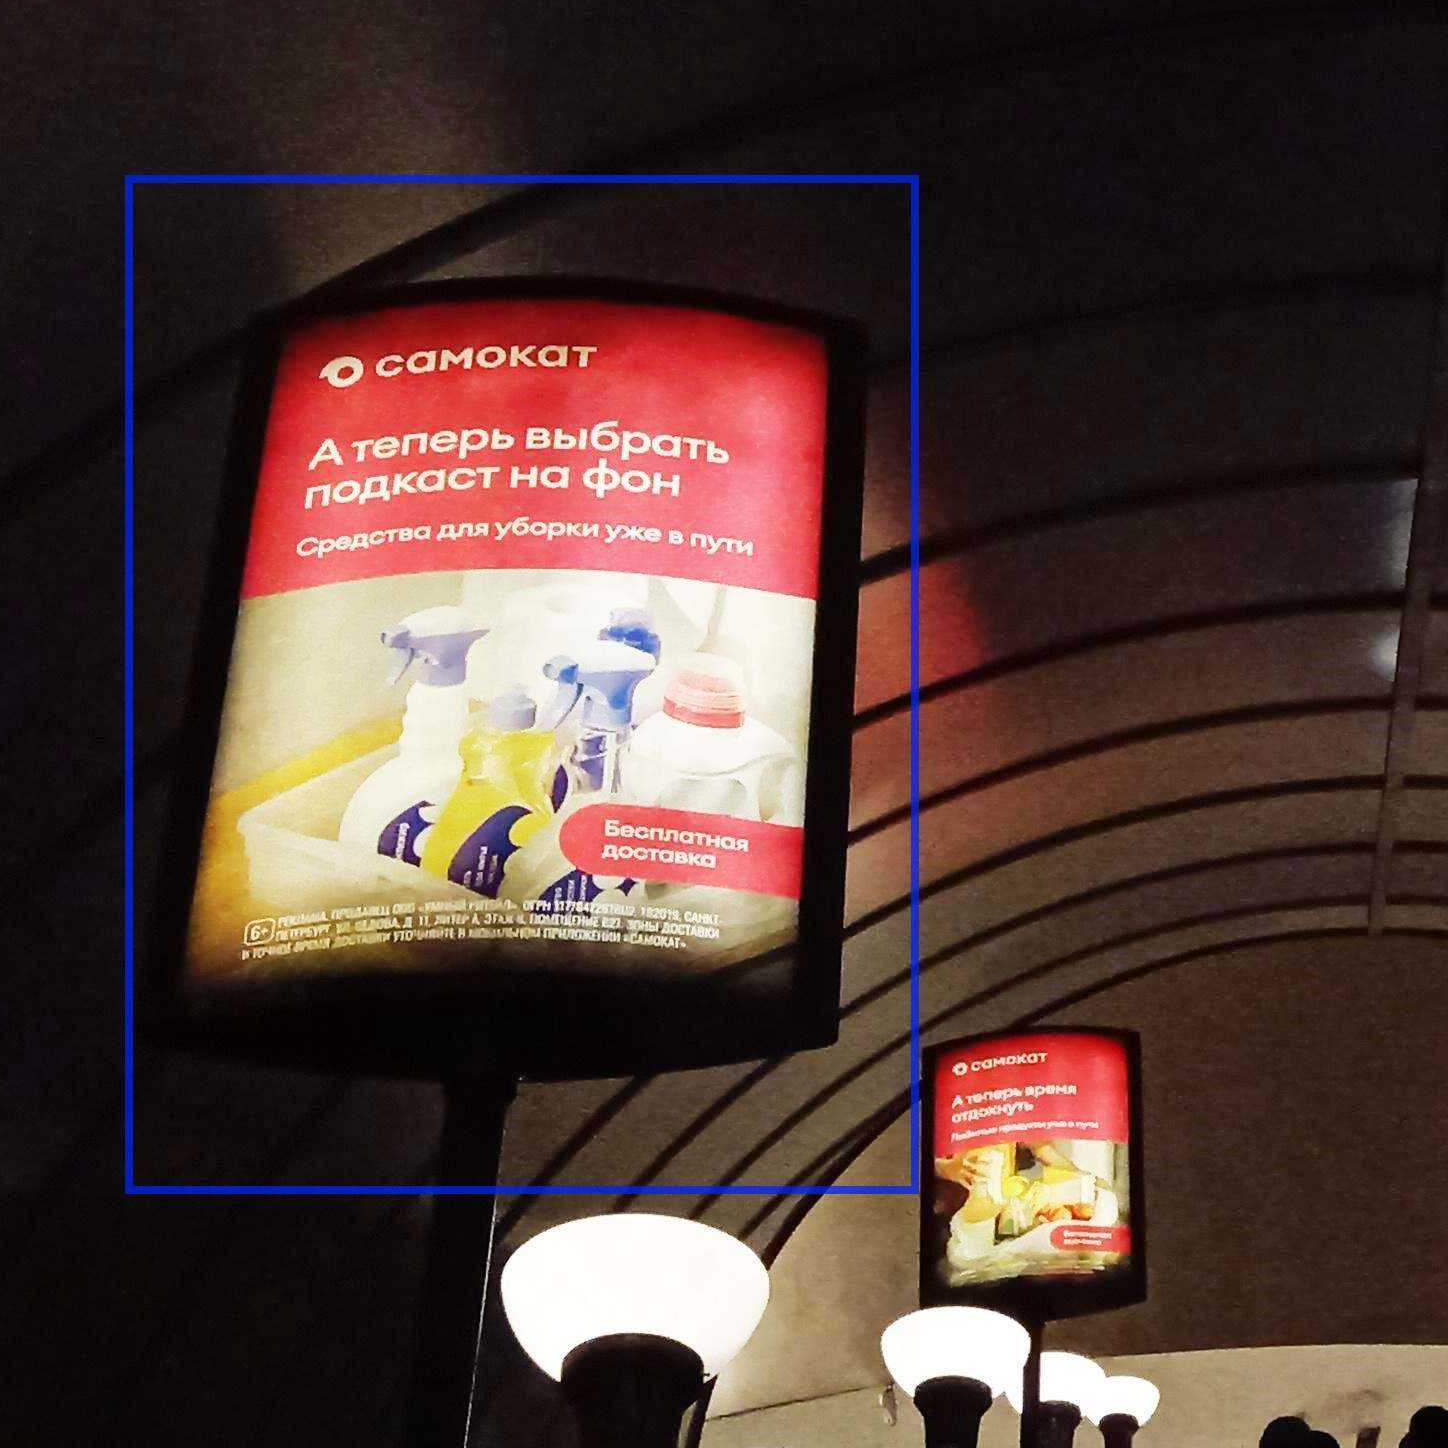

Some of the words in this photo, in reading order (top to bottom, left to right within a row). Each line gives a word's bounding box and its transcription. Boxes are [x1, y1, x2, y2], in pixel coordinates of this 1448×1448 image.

[375, 344, 598, 377] самокат
[308, 438, 344, 470] А
[351, 425, 515, 463] теперь
[525, 420, 730, 464] выбрать
[304, 466, 500, 510] подкаст
[510, 465, 570, 491] на
[583, 458, 681, 498] фон
[296, 521, 431, 558] Средства
[436, 520, 489, 541] для
[494, 516, 599, 541] уборки
[604, 525, 662, 544] уже
[669, 528, 684, 546] в
[690, 532, 754, 557] пути
[603, 818, 750, 853] Бесплатная
[601, 844, 718, 869] доставка
[250, 924, 270, 942] 6+
[661, 922, 720, 939] ДОСТАВКИ
[971, 1052, 1048, 1072] самокат
[952, 1094, 964, 1109] А
[966, 1087, 1023, 1104] теперь
[1025, 1084, 1078, 1098] время
